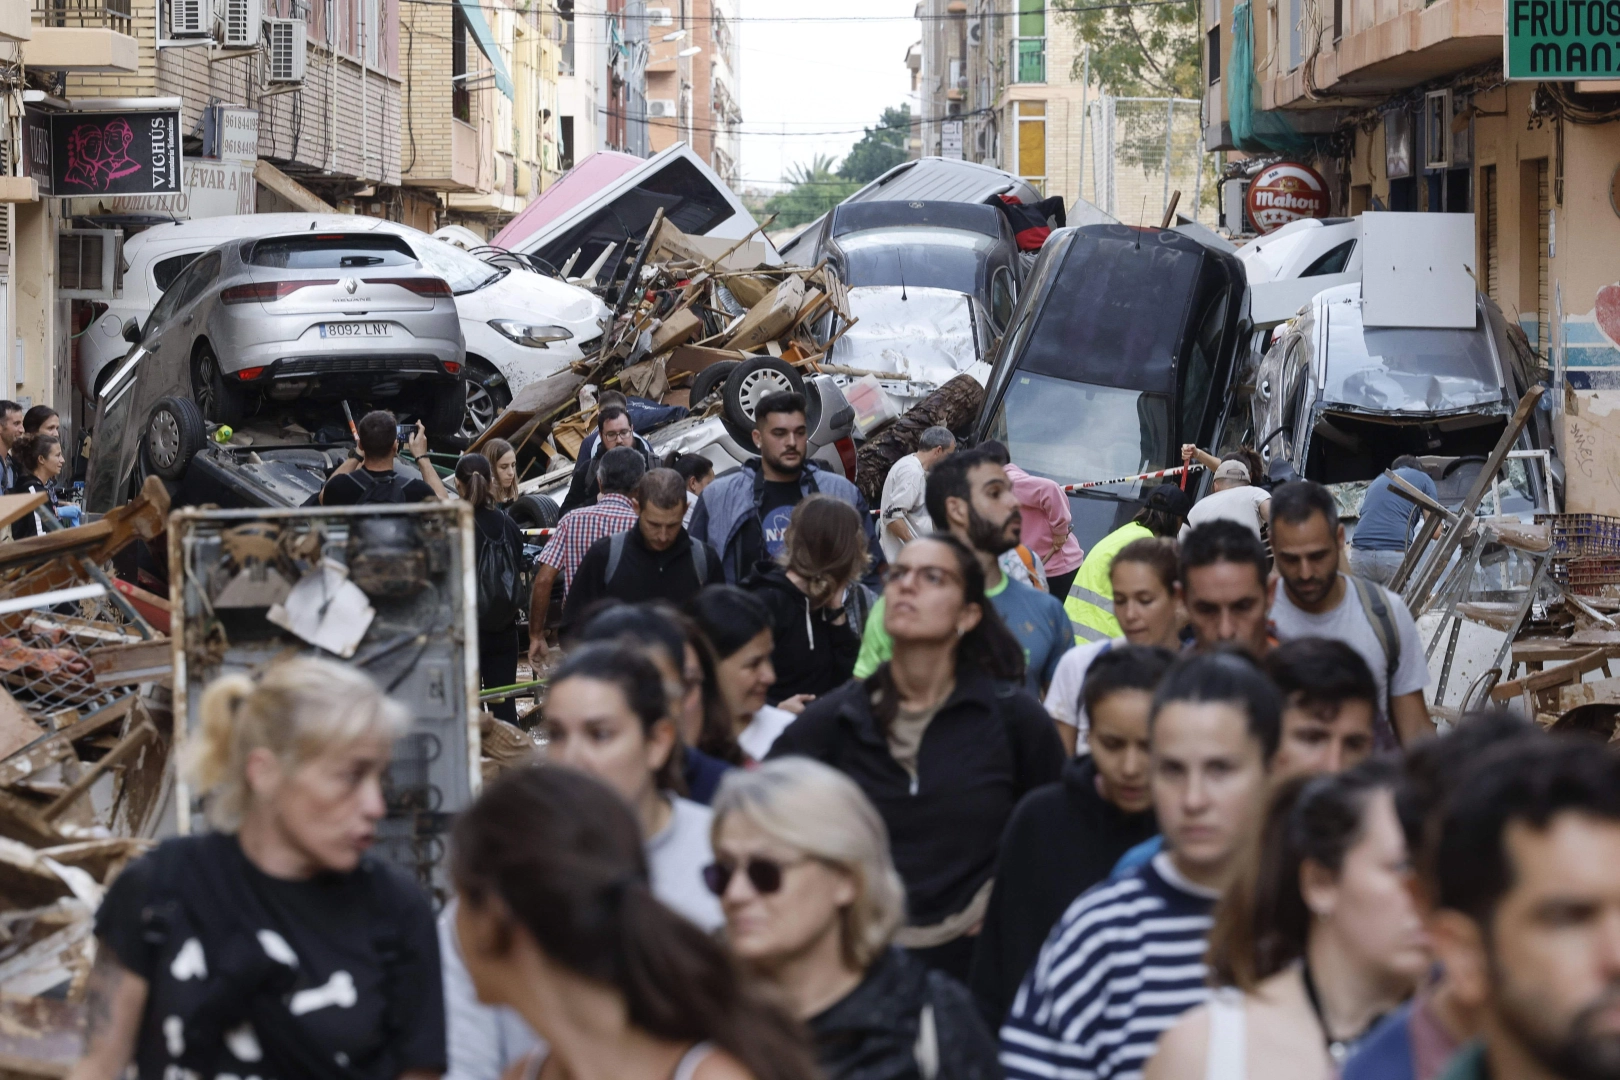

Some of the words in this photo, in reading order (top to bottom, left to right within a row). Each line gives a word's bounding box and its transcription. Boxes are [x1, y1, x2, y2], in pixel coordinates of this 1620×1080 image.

[1514, 1, 1620, 36] FRUTOS
[1531, 42, 1620, 72] MAN
[228, 170, 237, 190] A
[1268, 170, 1279, 178] BAR
[1256, 191, 1319, 210] Mahou
[329, 324, 361, 336] 8092
[365, 323, 388, 335] LNY
